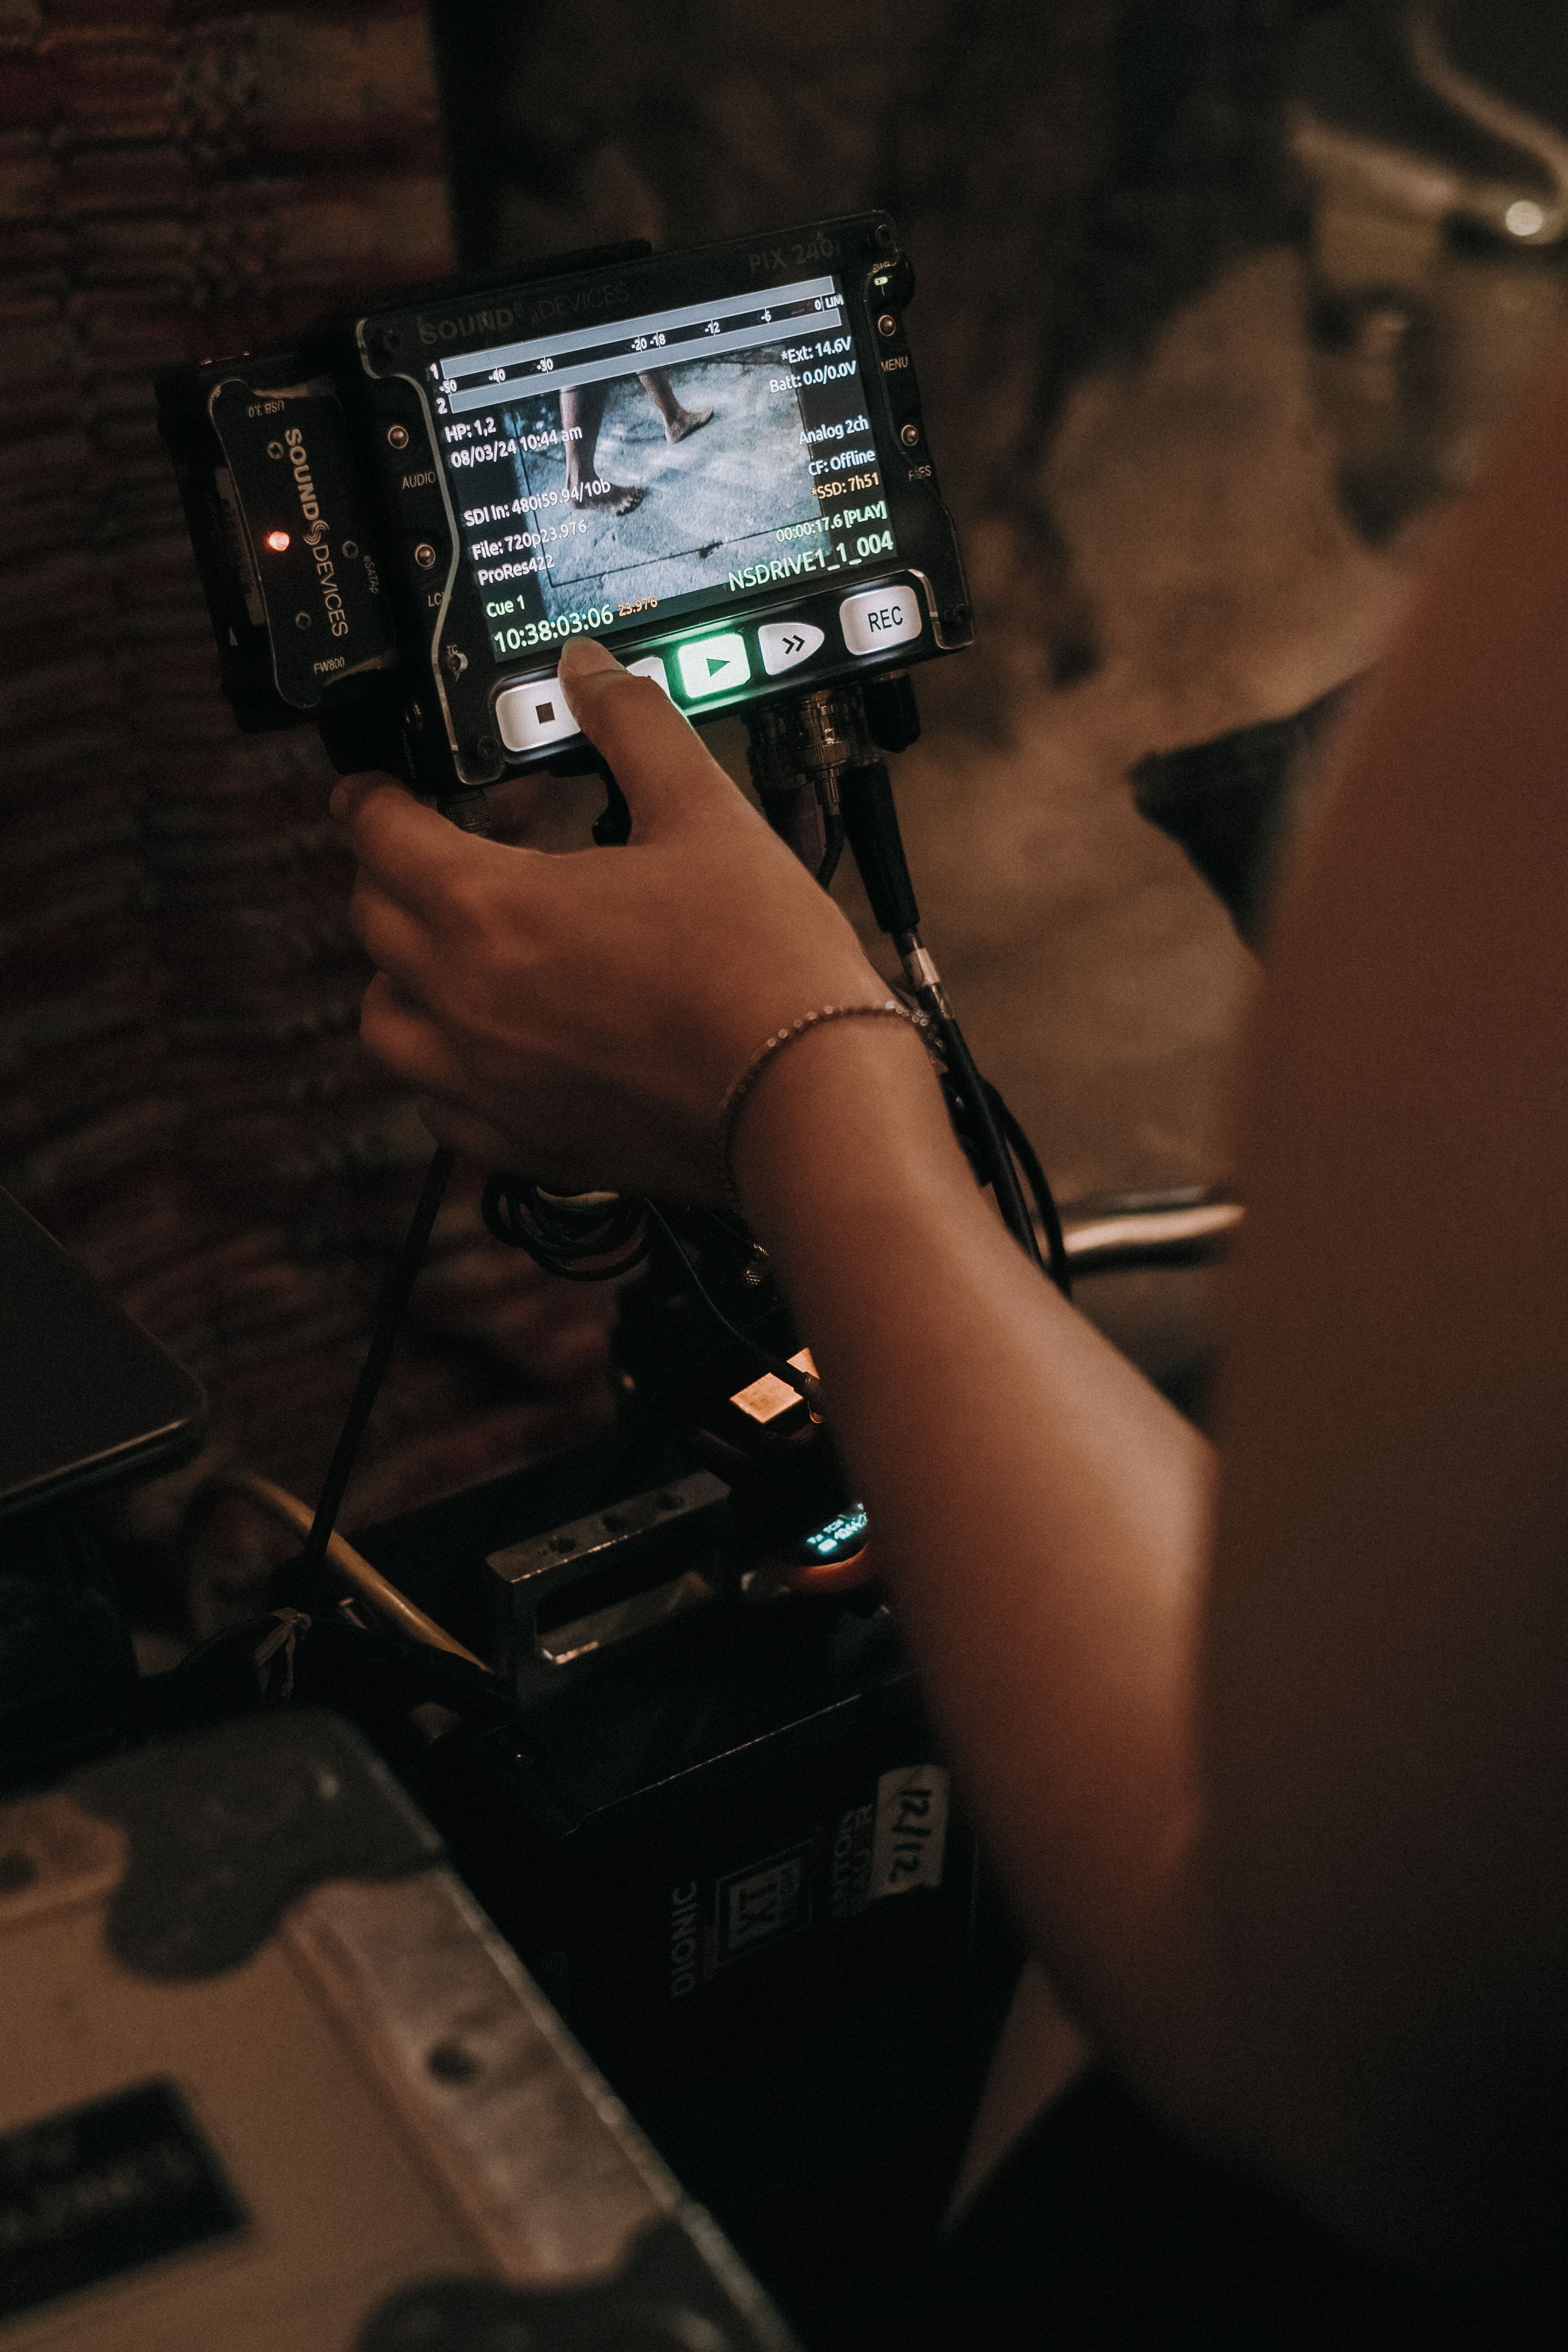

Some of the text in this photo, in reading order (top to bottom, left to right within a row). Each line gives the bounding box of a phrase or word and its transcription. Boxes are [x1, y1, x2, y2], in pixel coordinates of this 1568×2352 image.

[748, 246, 788, 274] PIX
[537, 358, 554, 372] -30
[704, 322, 720, 334] -12
[825, 295, 844, 309] LIM
[815, 336, 852, 357] 14.6V
[429, 363, 439, 380] 1
[769, 360, 857, 394] Batt: 0.0/0.0V
[881, 355, 909, 372] MENU
[264, 399, 285, 414] USB
[436, 397, 448, 415] 2
[445, 417, 497, 443] HP: 1,2
[799, 414, 870, 445] Analog 2ch
[451, 426, 582, 468] 08/03/24 10:44 am
[808, 448, 876, 477] CF: Offline
[402, 471, 437, 490] AUDIO
[848, 472, 880, 491] 7h51
[463, 477, 611, 527] SDI In: 480i59.94/10b
[285, 428, 349, 637] SOUND DEVICES
[775, 500, 888, 543] 00:00:17.6 [PLAY]
[472, 519, 587, 560] File: 720p23.976
[478, 555, 555, 586] ProRes422
[728, 530, 894, 592] NSDRIVE1_1_004
[428, 591, 453, 608] LC
[486, 594, 525, 617] Cue 1
[494, 595, 658, 652] 10:38:03:06 23.976
[867, 605, 903, 633] REC
[314, 657, 345, 674] FW800
[670, 1880, 698, 1998] DIONIC
